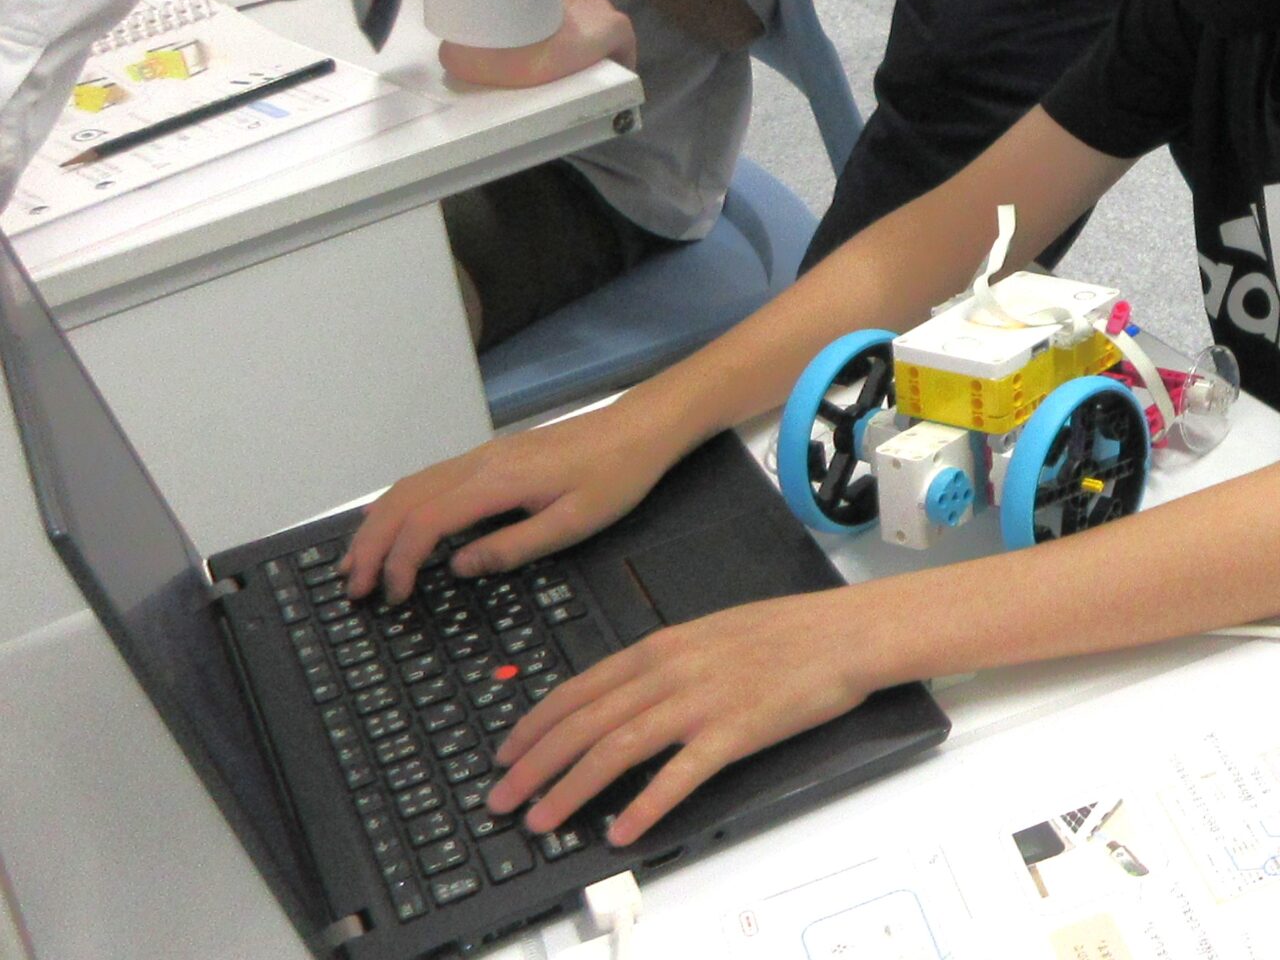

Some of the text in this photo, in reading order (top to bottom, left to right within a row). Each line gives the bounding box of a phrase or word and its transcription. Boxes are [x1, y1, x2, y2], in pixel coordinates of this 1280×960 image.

[387, 623, 403, 634] O
[444, 623, 459, 634] K
[527, 661, 543, 672] B
[408, 669, 424, 680] U
[466, 670, 481, 680] H
[533, 687, 552, 696] V
[418, 694, 434, 703] Y
[429, 719, 445, 728] T
[441, 742, 457, 753] R
[452, 768, 469, 779] E
[463, 793, 480, 806] W
[476, 821, 493, 833] Q
